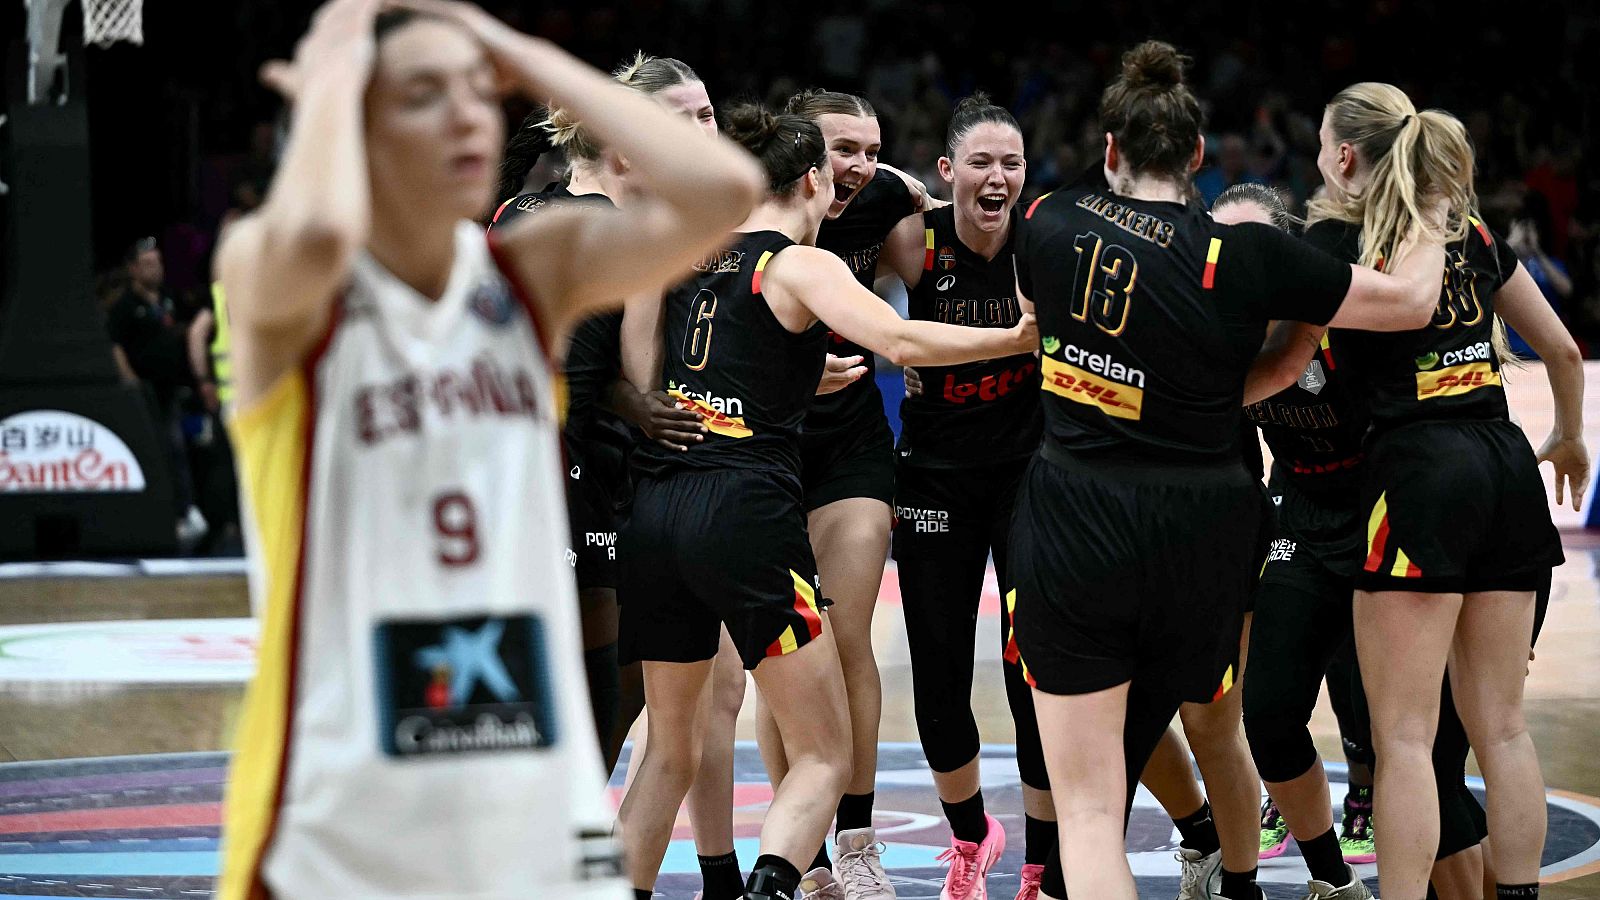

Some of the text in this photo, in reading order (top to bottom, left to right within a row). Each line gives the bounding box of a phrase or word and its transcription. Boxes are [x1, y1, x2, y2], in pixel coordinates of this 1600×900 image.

[1076, 194, 1176, 248] LINSKENS
[1070, 230, 1138, 337] 13
[682, 287, 718, 372] 6
[1053, 371, 1123, 408] DHL
[1064, 344, 1146, 388] crelan
[432, 491, 481, 568] 9
[896, 505, 949, 521] POWER
[915, 520, 950, 533] ADE
